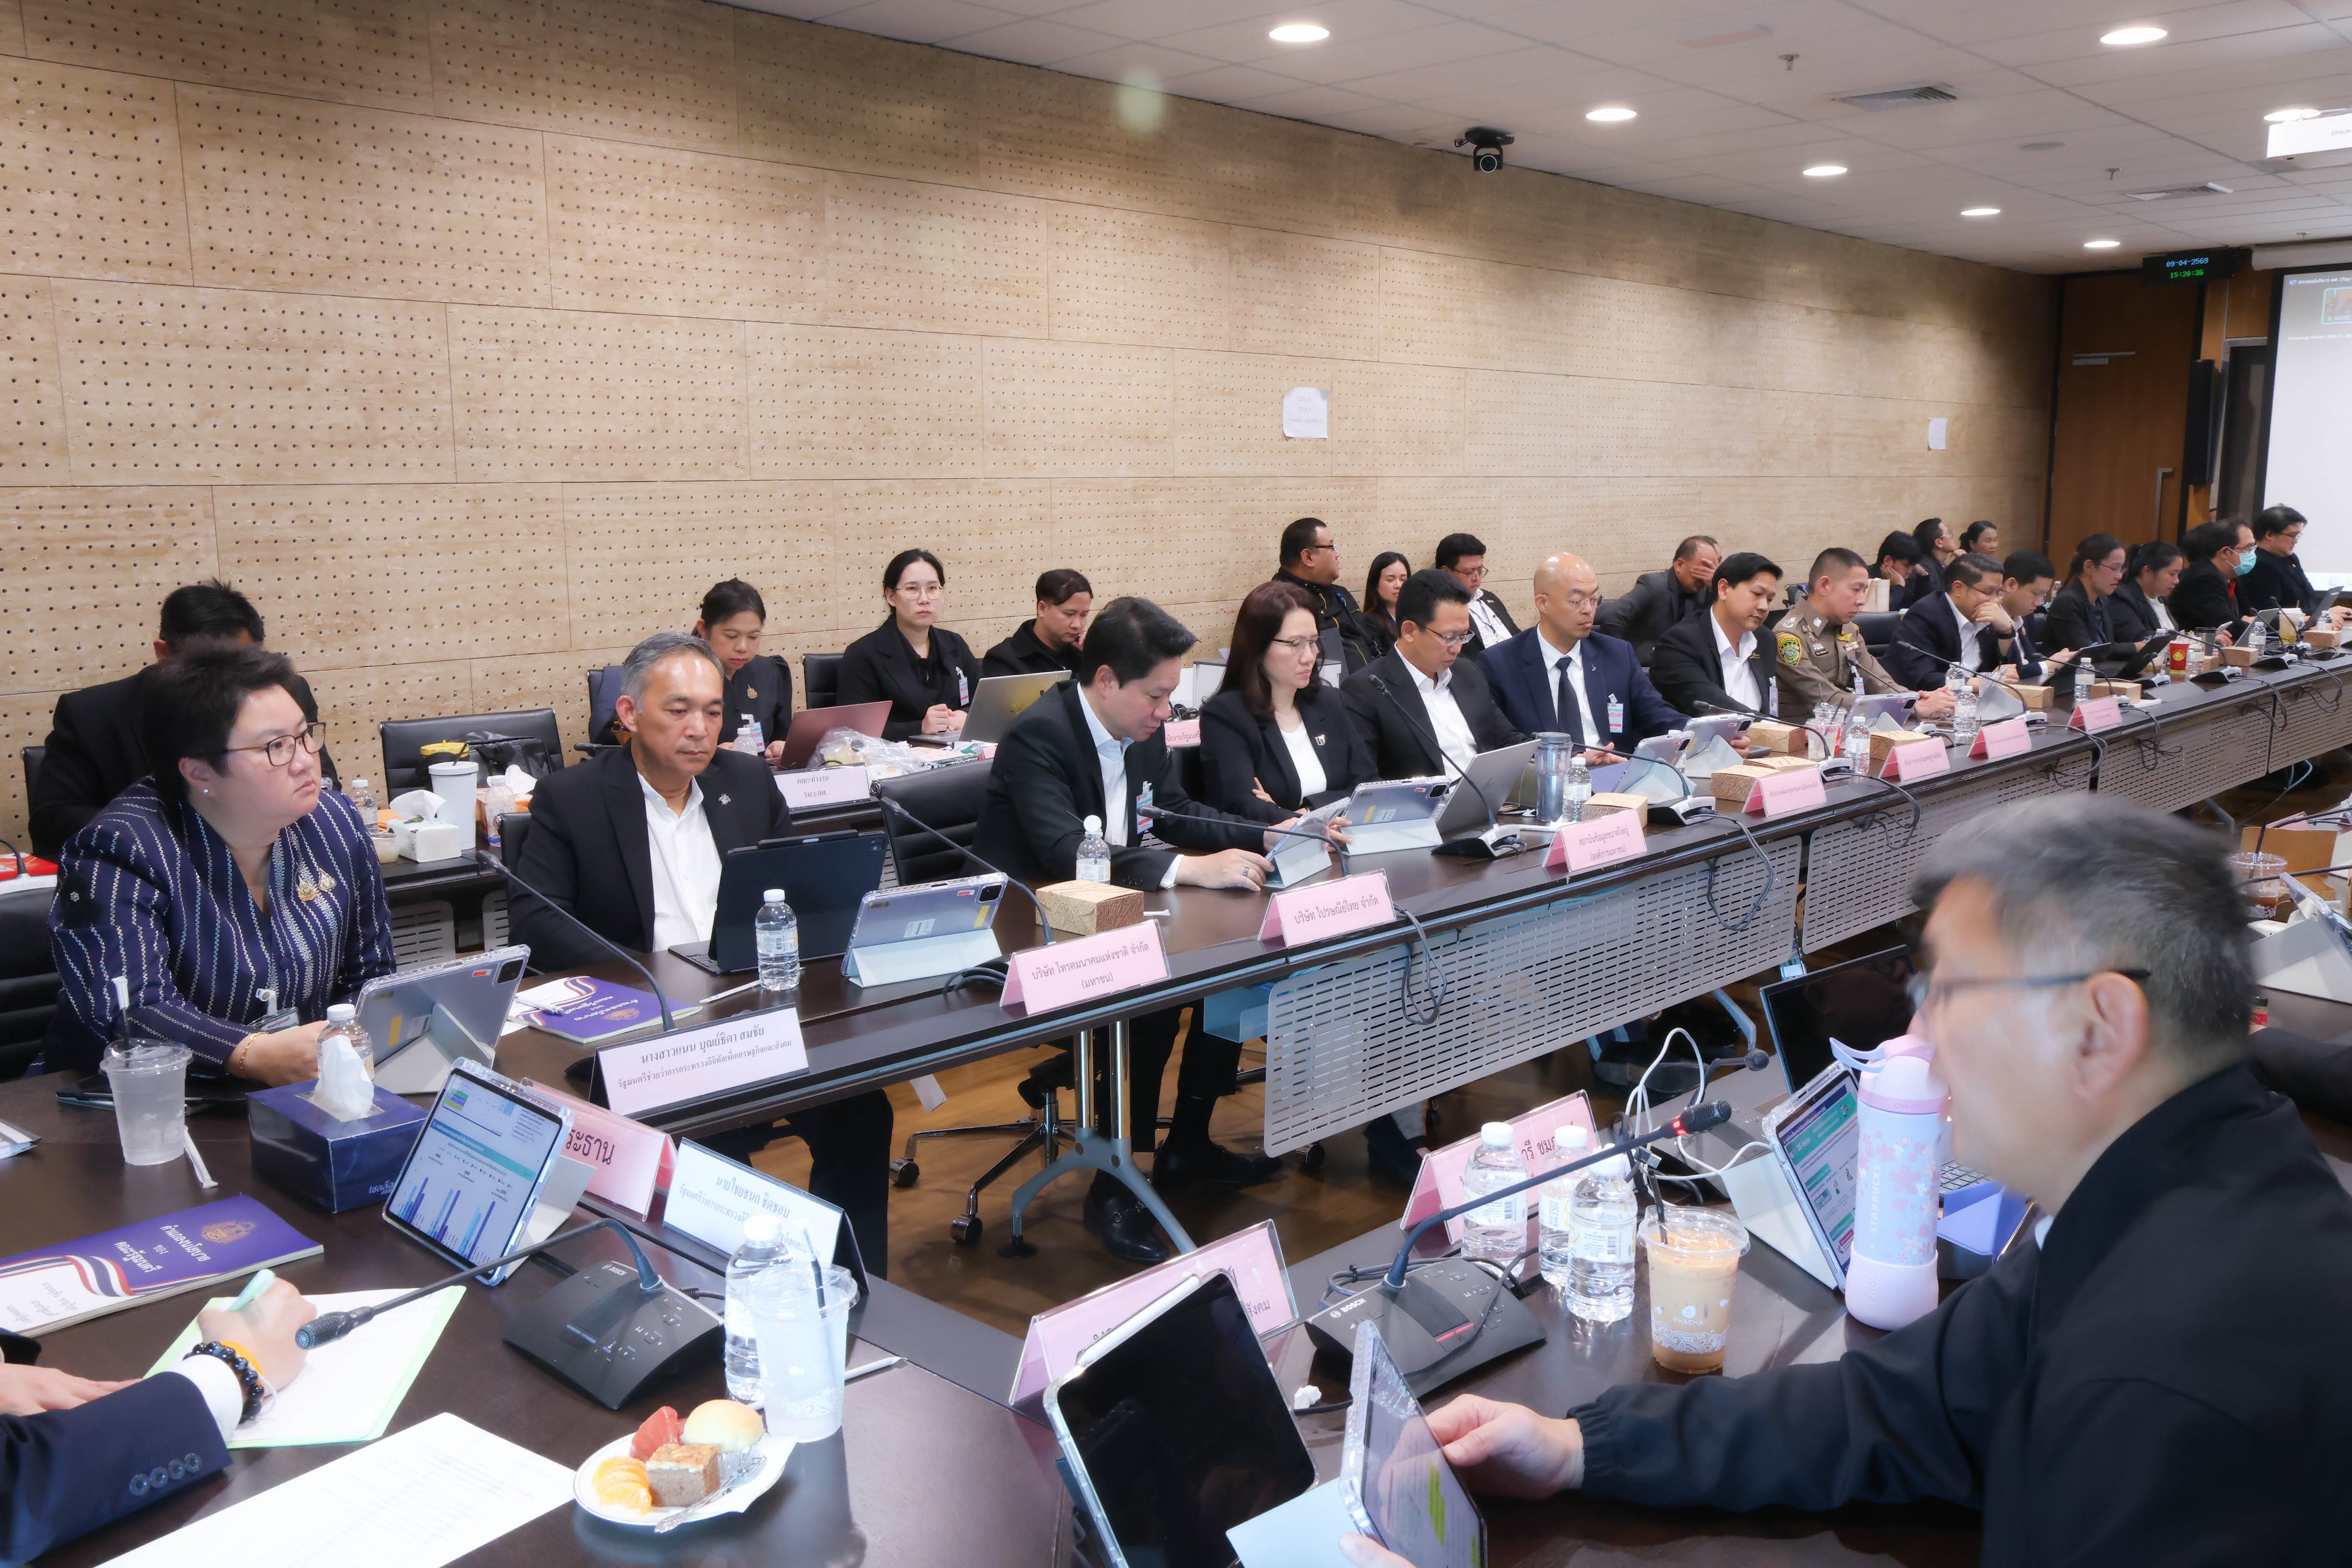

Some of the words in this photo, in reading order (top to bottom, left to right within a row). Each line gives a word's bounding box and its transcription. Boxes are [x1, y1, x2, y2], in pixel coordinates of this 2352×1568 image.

[2166, 257, 2209, 268] 09-04-2569
[2170, 268, 2204, 279] 15:20:36
[797, 775, 829, 784] คณะทำงาน
[1578, 825, 1629, 846] สถาบันข้อมูลขนาดใหญ่
[1590, 844, 1626, 861] (องค์การมหาชน)
[1294, 908, 1315, 924] บริษัท
[1316, 899, 1359, 919] ไปรษณีย์ไทย
[1361, 894, 1379, 908] จำกัด
[1031, 964, 1055, 980] บริษัท
[1055, 946, 1128, 974] โทรคมนาคมแห่งชาติ
[1130, 941, 1149, 954] จำกัด
[1081, 972, 1113, 989] (มหาชน)
[641, 1042, 696, 1064] นางสาวแนน
[699, 1031, 738, 1053] บุณย์ธิดา
[740, 1023, 764, 1040] สมชัย
[618, 1038, 792, 1090] รัฐมนตรีช่วยว่าการกระทรวงดิจิทัลเพื่อเศรษฐกิจและสังคม
[715, 1175, 761, 1204] นายไชยชนก
[762, 1191, 790, 1218] ชิดชอบ
[1870, 1164, 1881, 1234] STARBUCKS
[153, 1244, 169, 1254] ของ
[160, 1225, 211, 1262] คำแถลงนโยบาย
[114, 1241, 163, 1273] คณะรัฐมนตรี
[608, 1266, 627, 1276] BOSCH
[1340, 1298, 1367, 1313] BOSCH
[1673, 1317, 1704, 1326] PHACHA
